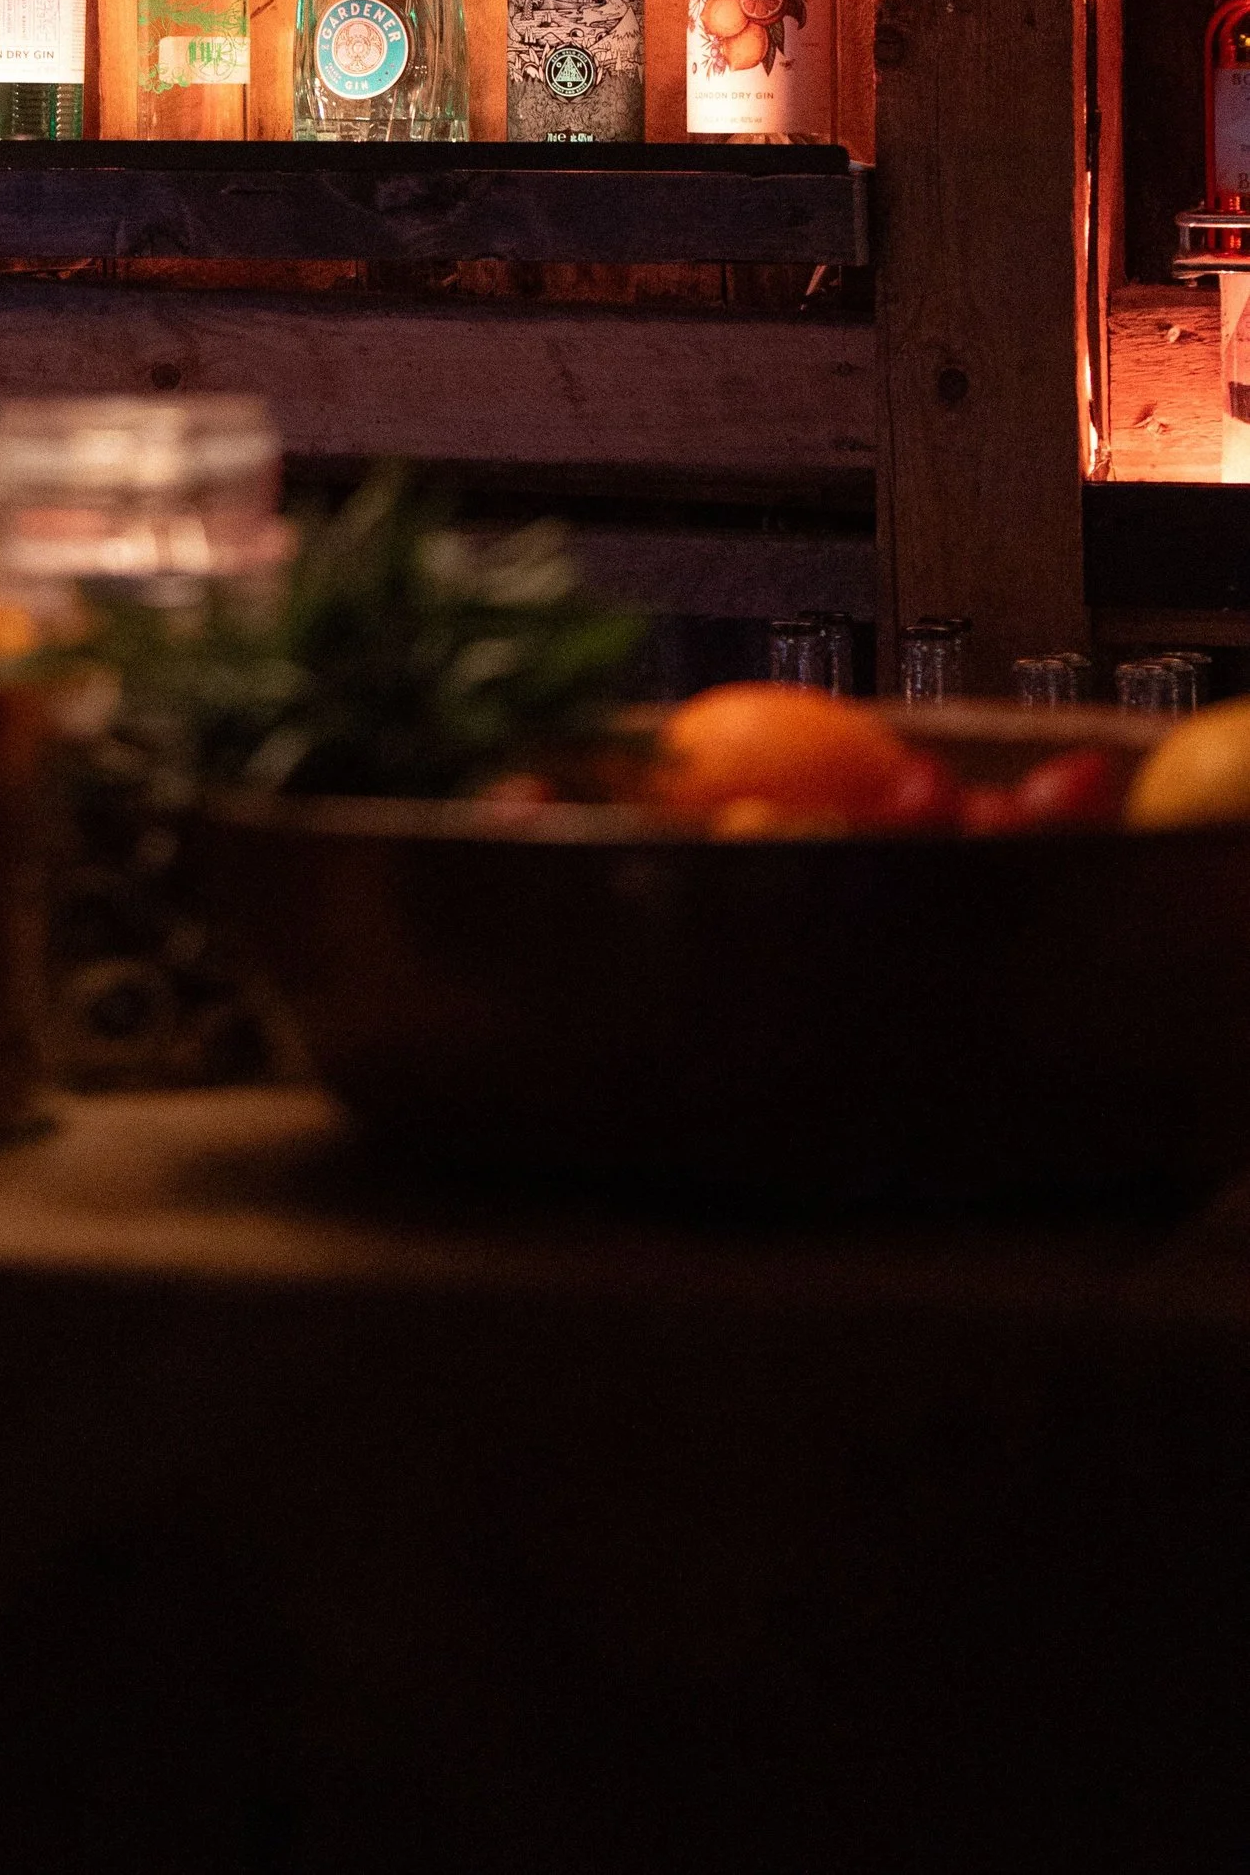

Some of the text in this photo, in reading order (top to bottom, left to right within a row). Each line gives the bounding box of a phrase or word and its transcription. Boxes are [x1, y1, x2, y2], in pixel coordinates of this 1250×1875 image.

[322, 2, 401, 43] GARDENER
[7, 50, 29, 59] DRY
[34, 50, 55, 59] GIN
[344, 80, 369, 91] GIN
